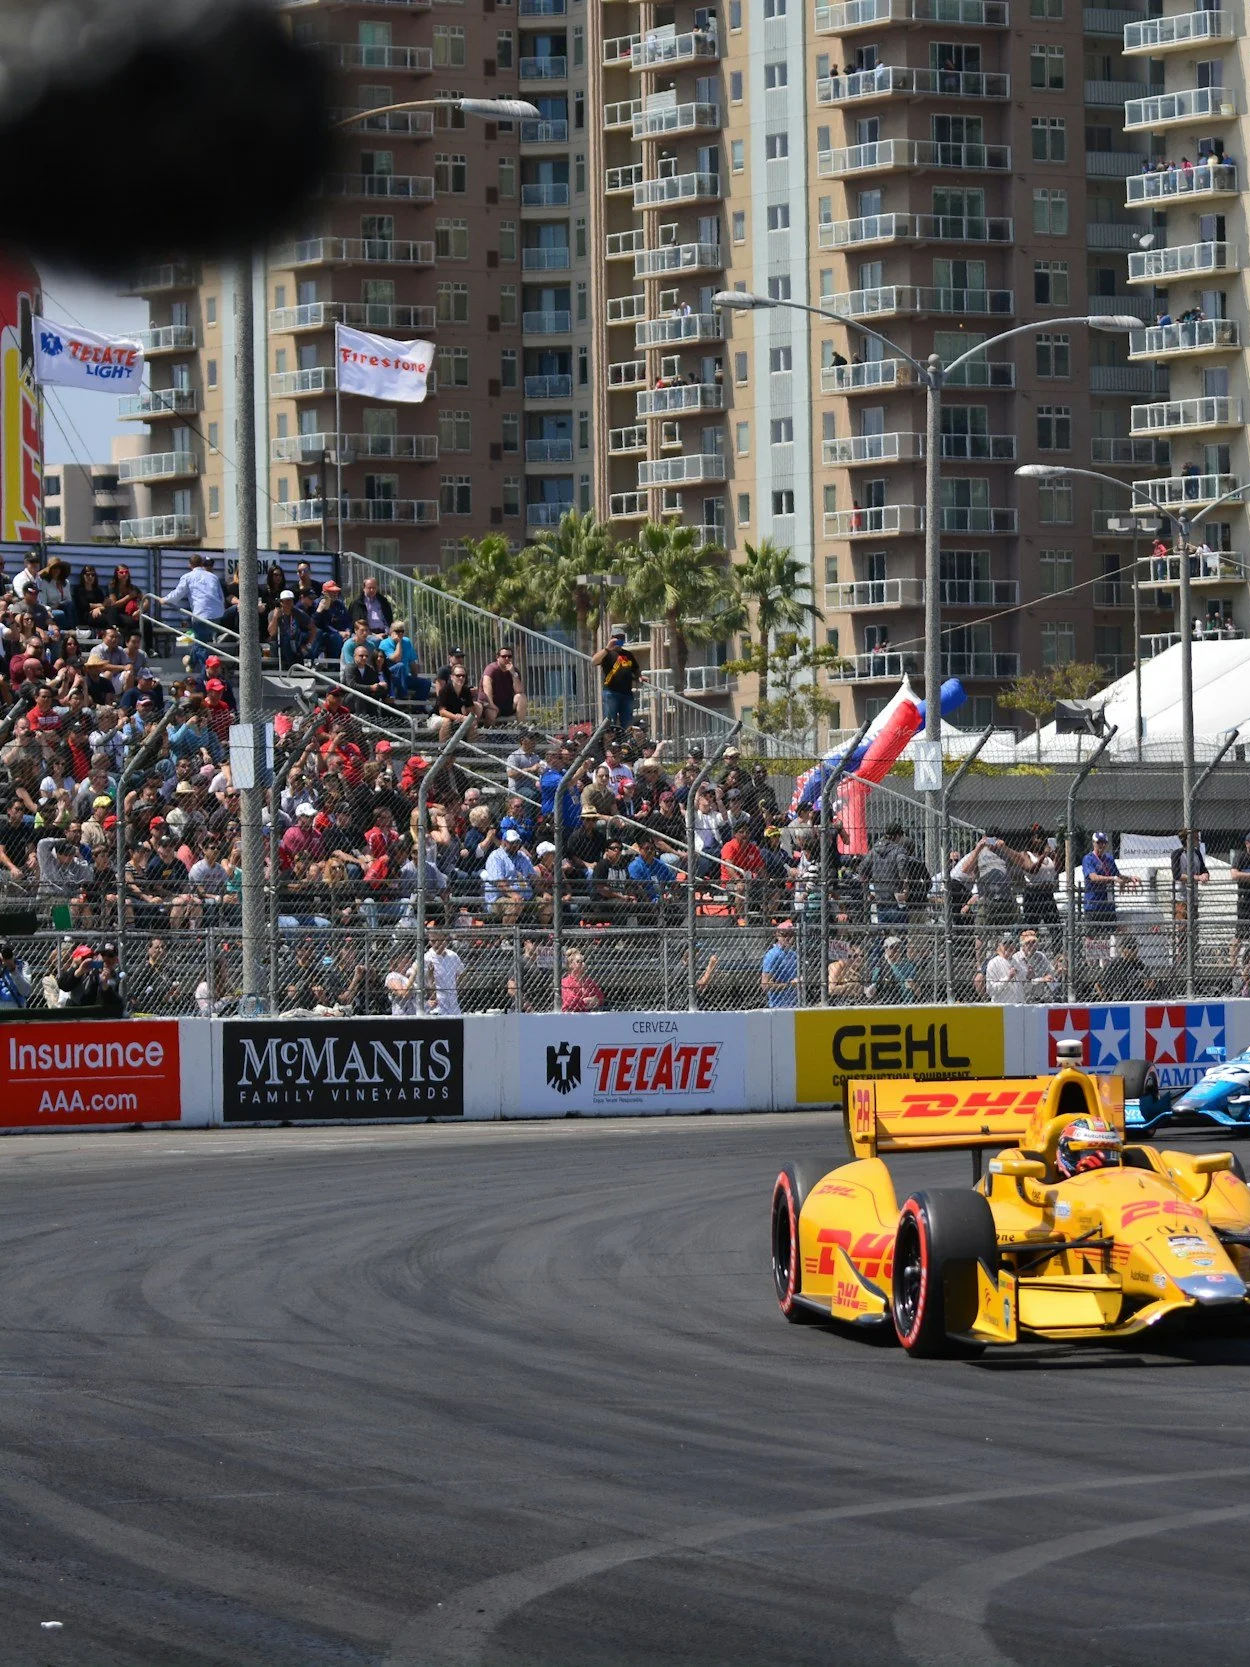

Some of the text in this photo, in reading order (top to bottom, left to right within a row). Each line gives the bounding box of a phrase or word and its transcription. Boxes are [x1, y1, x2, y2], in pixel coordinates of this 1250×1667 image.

[67, 340, 138, 367] TECATE
[340, 347, 426, 373] Firestone
[86, 364, 133, 379] LIGHT
[919, 746, 937, 784] K
[632, 1021, 678, 1033] CERVEZA
[9, 1038, 163, 1071] Insurance
[832, 1024, 971, 1070] GEHL
[593, 1042, 717, 1091] TECATE
[1156, 1067, 1207, 1087] AMI
[39, 1089, 138, 1113] AAA.com
[239, 1086, 449, 1103] FAMILY VINEYARDS
[1120, 1200, 1204, 1229] 28
[816, 1228, 894, 1278] DH
[836, 1281, 860, 1309] DHL
